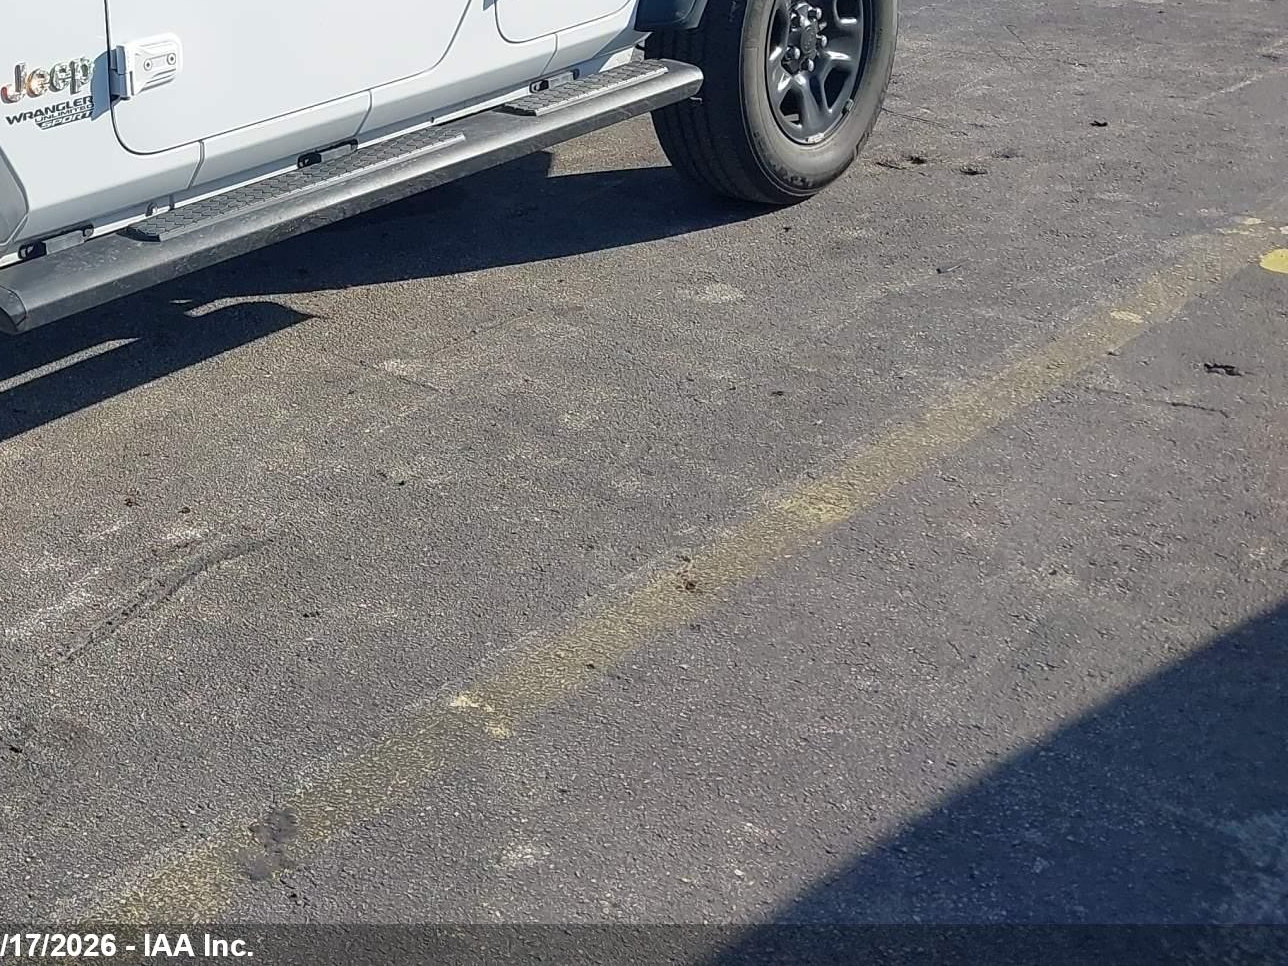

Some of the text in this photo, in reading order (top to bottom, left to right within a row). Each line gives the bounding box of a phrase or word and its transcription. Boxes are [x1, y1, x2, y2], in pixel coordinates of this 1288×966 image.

[0, 58, 92, 104] Jeep
[5, 95, 94, 126] WRANGLER
[34, 103, 95, 123] UNLIMITED
